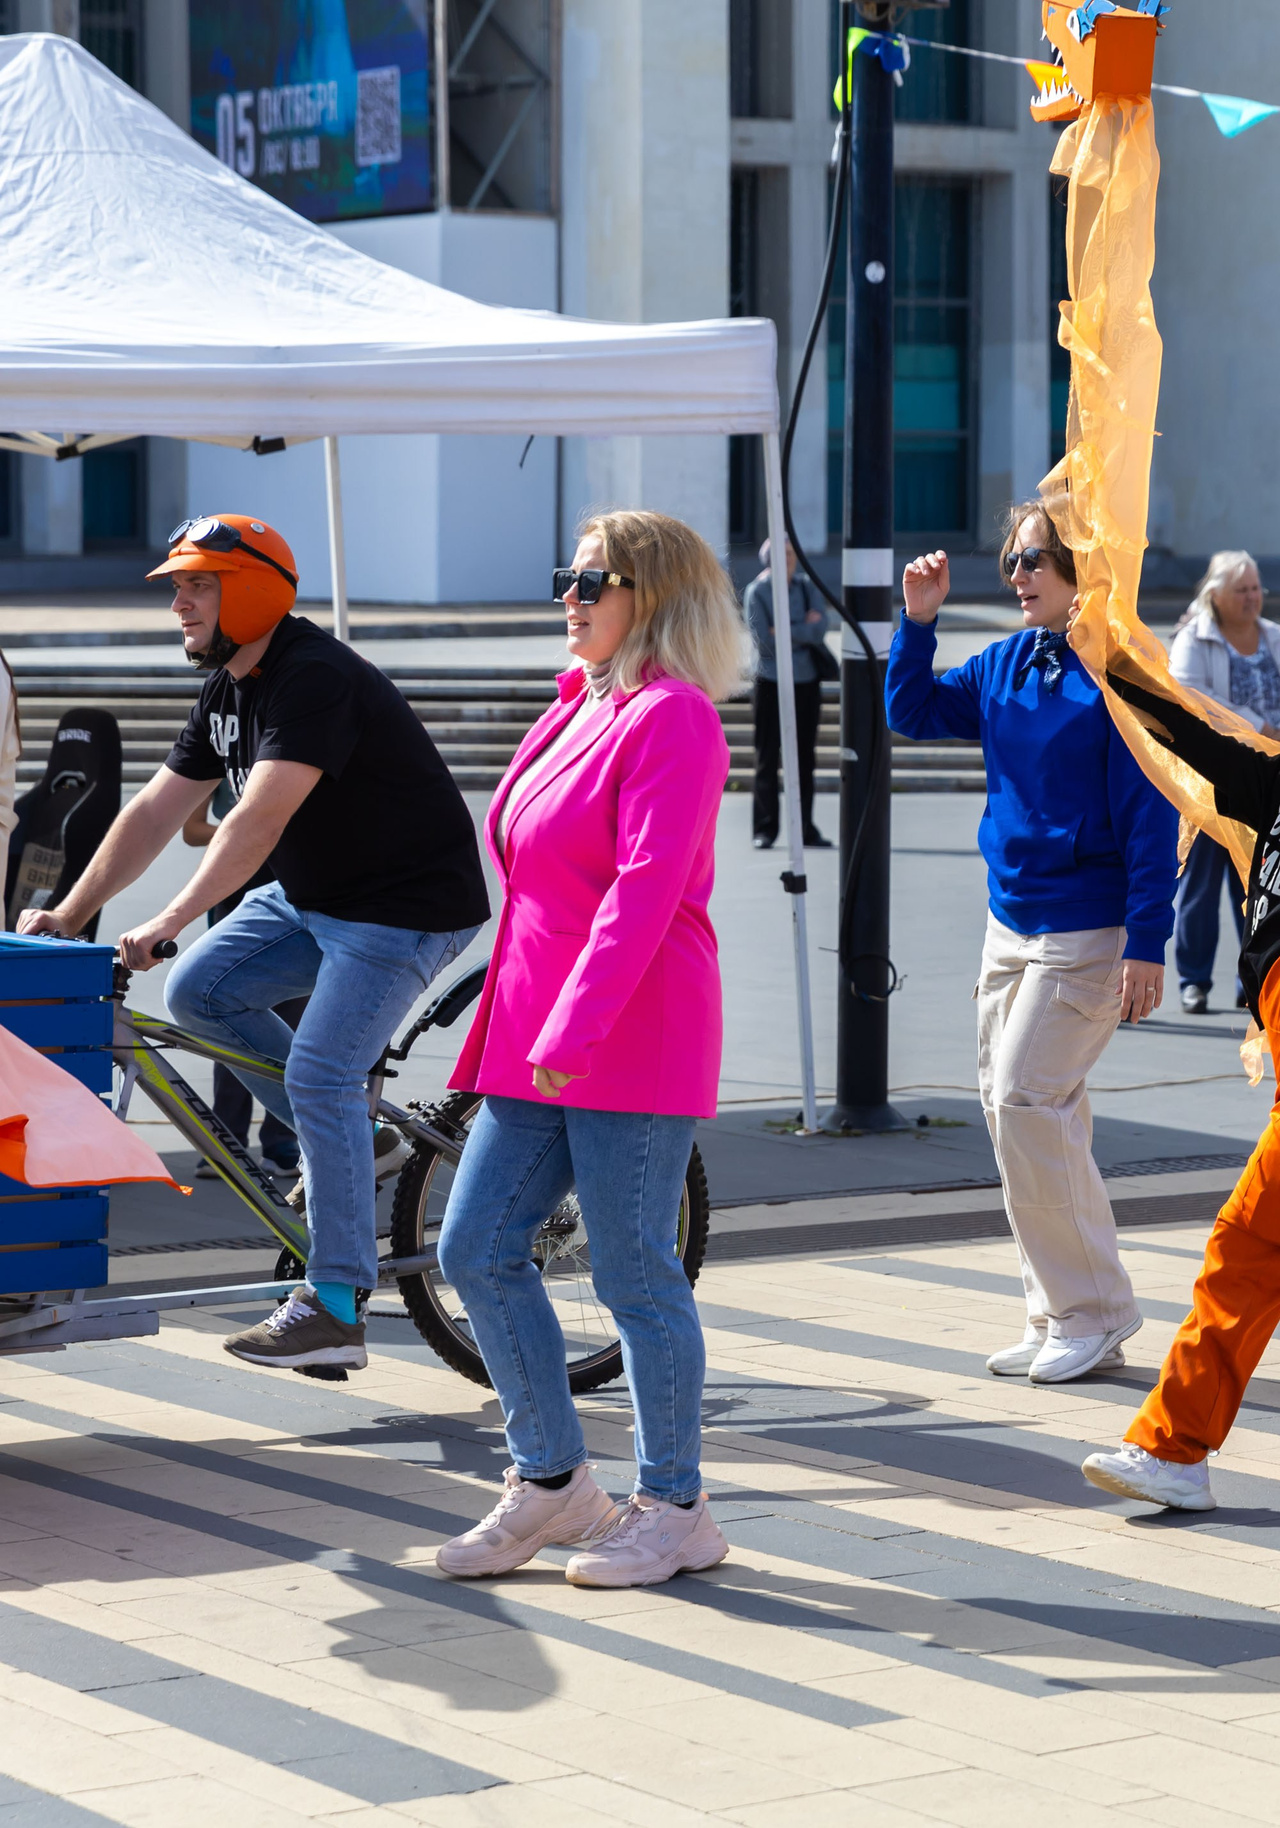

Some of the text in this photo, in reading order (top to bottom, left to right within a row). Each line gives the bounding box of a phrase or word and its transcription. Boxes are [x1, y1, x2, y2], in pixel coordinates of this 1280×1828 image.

[216, 80, 338, 177] 05 ОКТЯБРЯ
[58, 728, 92, 743] BRIDE
[169, 1079, 292, 1208] FORWARD
